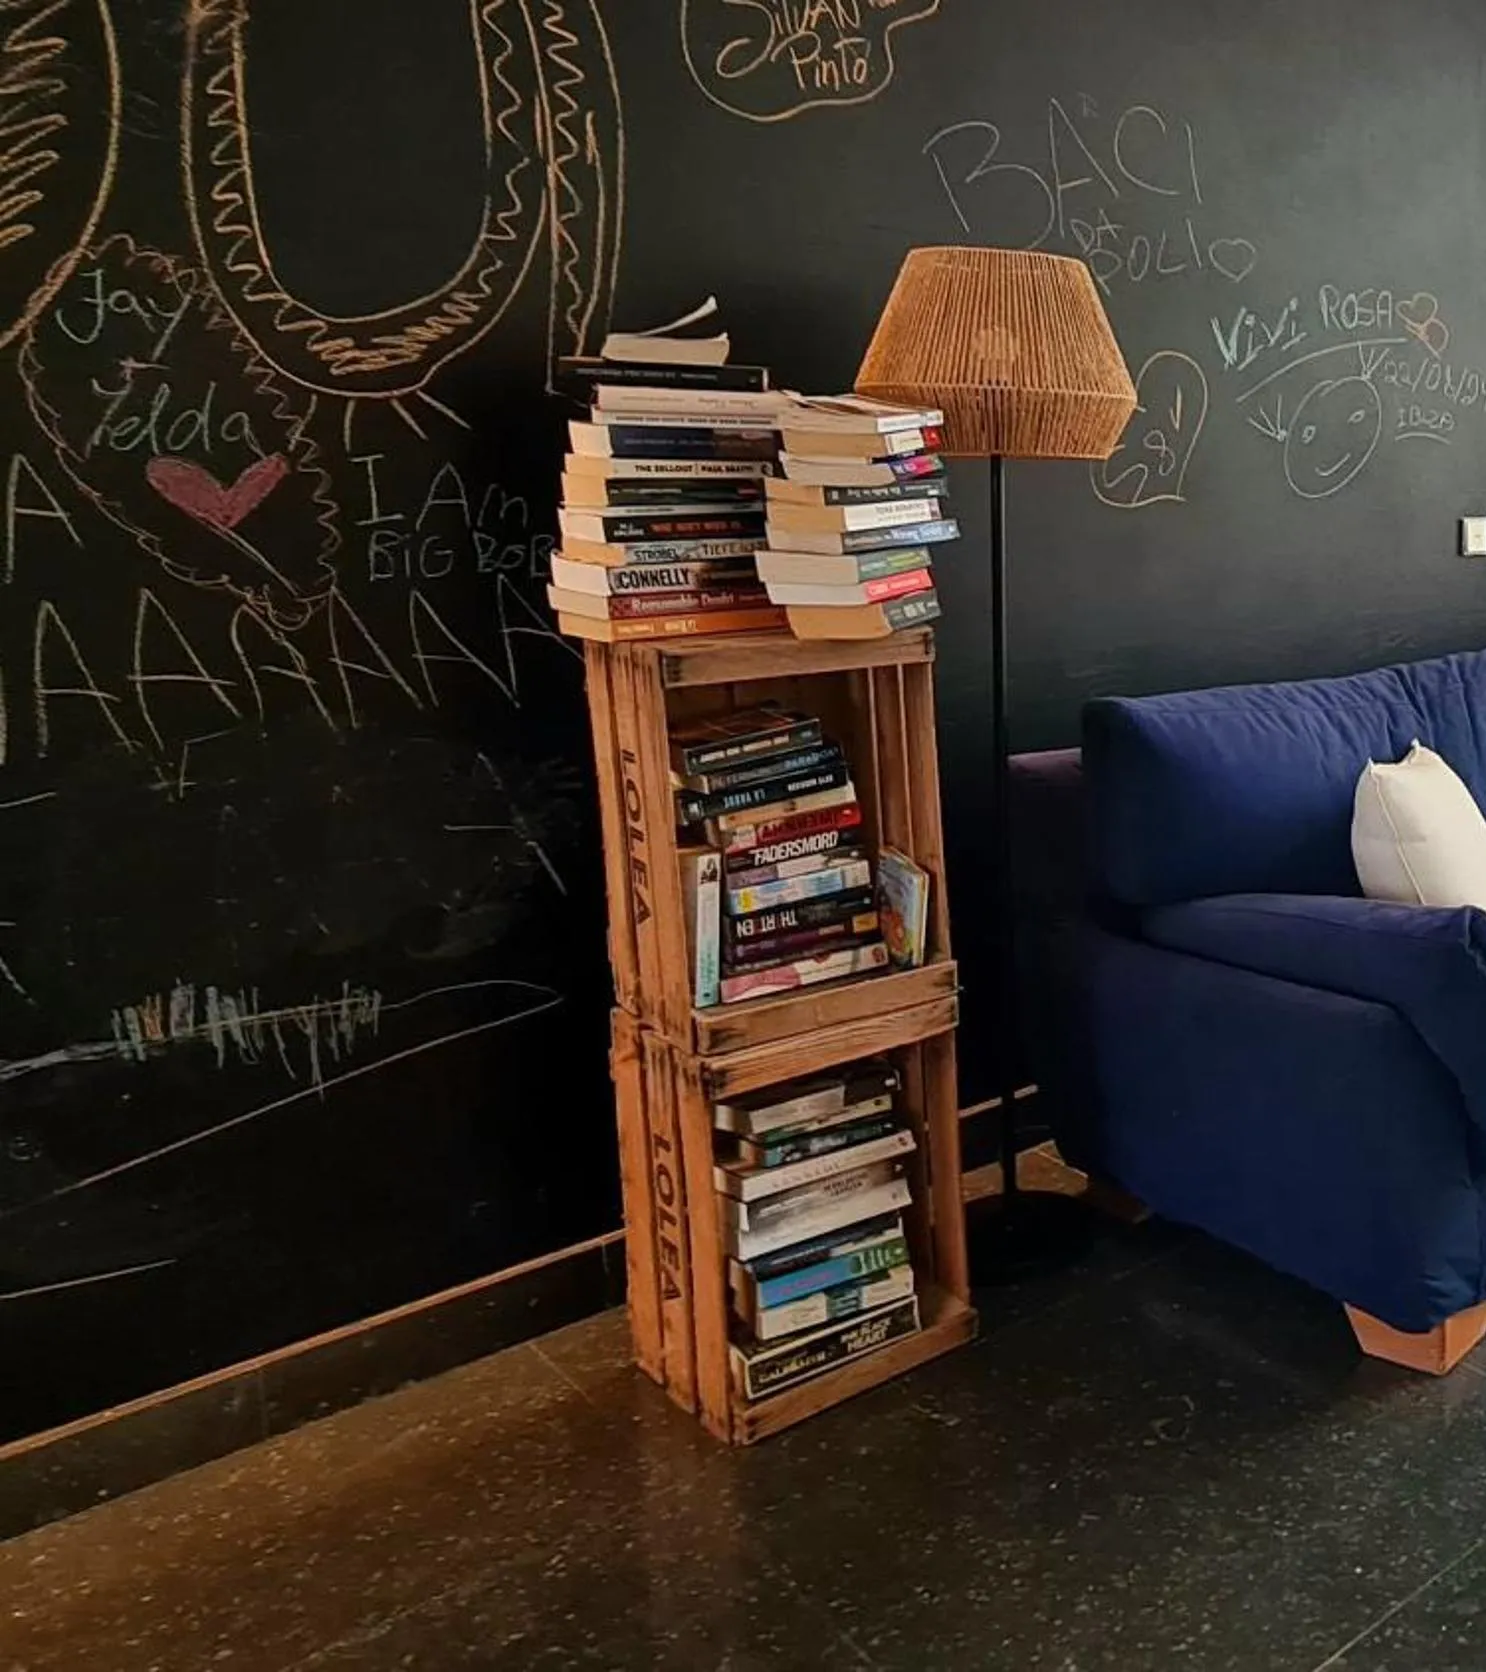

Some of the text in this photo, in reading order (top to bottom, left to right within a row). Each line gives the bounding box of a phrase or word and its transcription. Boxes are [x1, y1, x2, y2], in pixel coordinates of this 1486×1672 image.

[922, 97, 1202, 250] BACI
[1318, 284, 1393, 330] ROSA
[634, 464, 652, 474] THE
[654, 464, 693, 474] SELLOUT
[618, 567, 691, 589] CONNELLY
[621, 749, 652, 925] LOLEA
[749, 830, 839, 866] FADERSMORD
[653, 1132, 682, 1301] LOLEA
